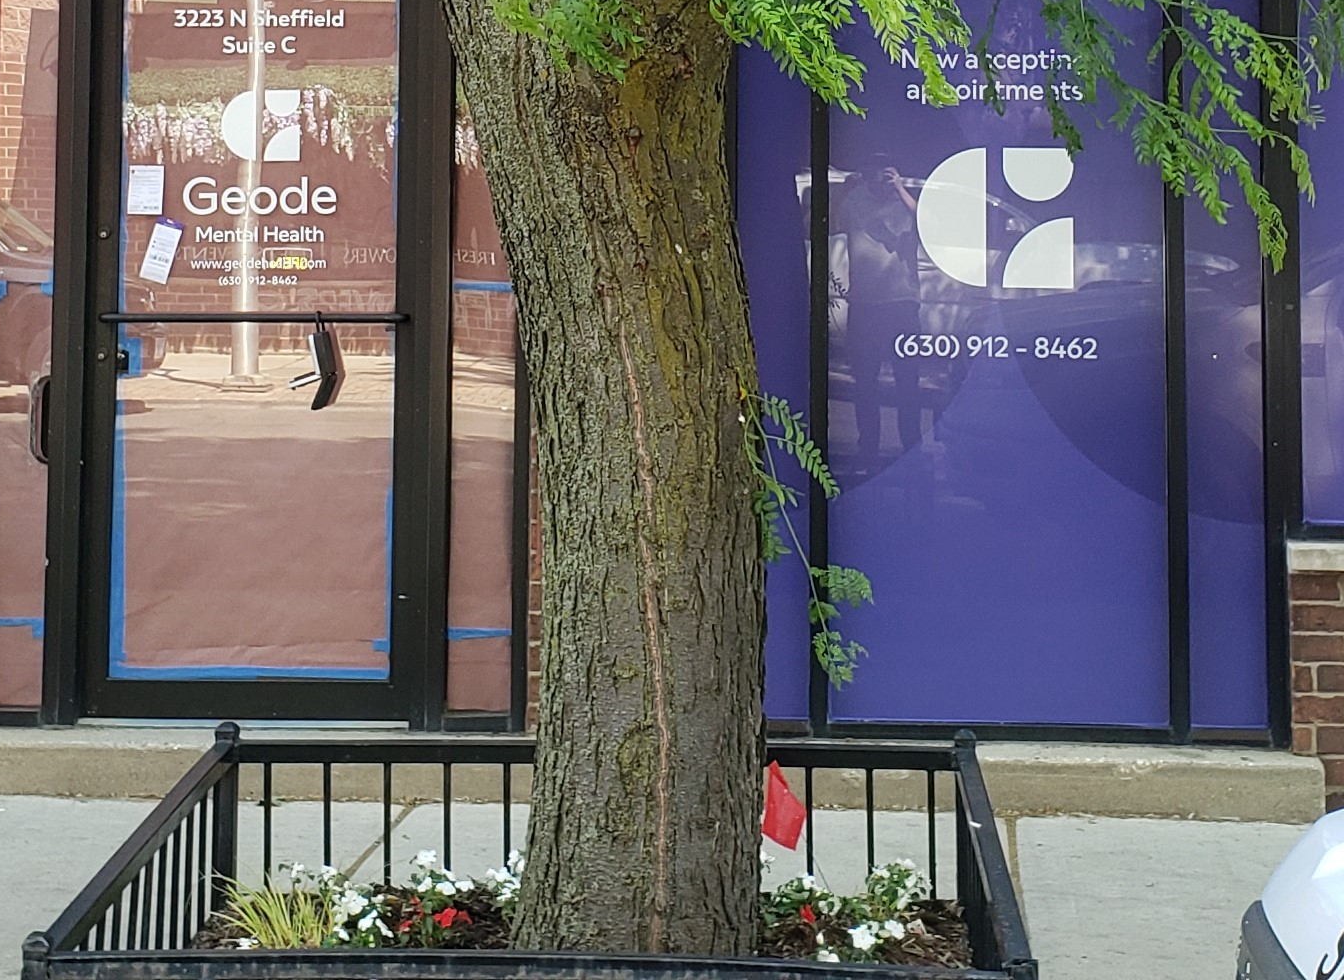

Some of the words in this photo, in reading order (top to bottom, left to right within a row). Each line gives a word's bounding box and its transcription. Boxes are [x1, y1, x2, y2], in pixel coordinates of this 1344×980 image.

[173, 9, 223, 28] 3223
[230, 9, 247, 28] N
[253, 8, 344, 28] Sheffield
[222, 36, 276, 55] Suite
[281, 36, 296, 54] C
[901, 48, 959, 69] Nw
[965, 48, 1081, 75] aceptin
[182, 177, 337, 217] Geode
[195, 225, 259, 244] Mental
[263, 225, 325, 244] Health
[894, 333, 960, 360] (630)
[966, 335, 1009, 359] 912
[1034, 336, 1099, 360] 8462
